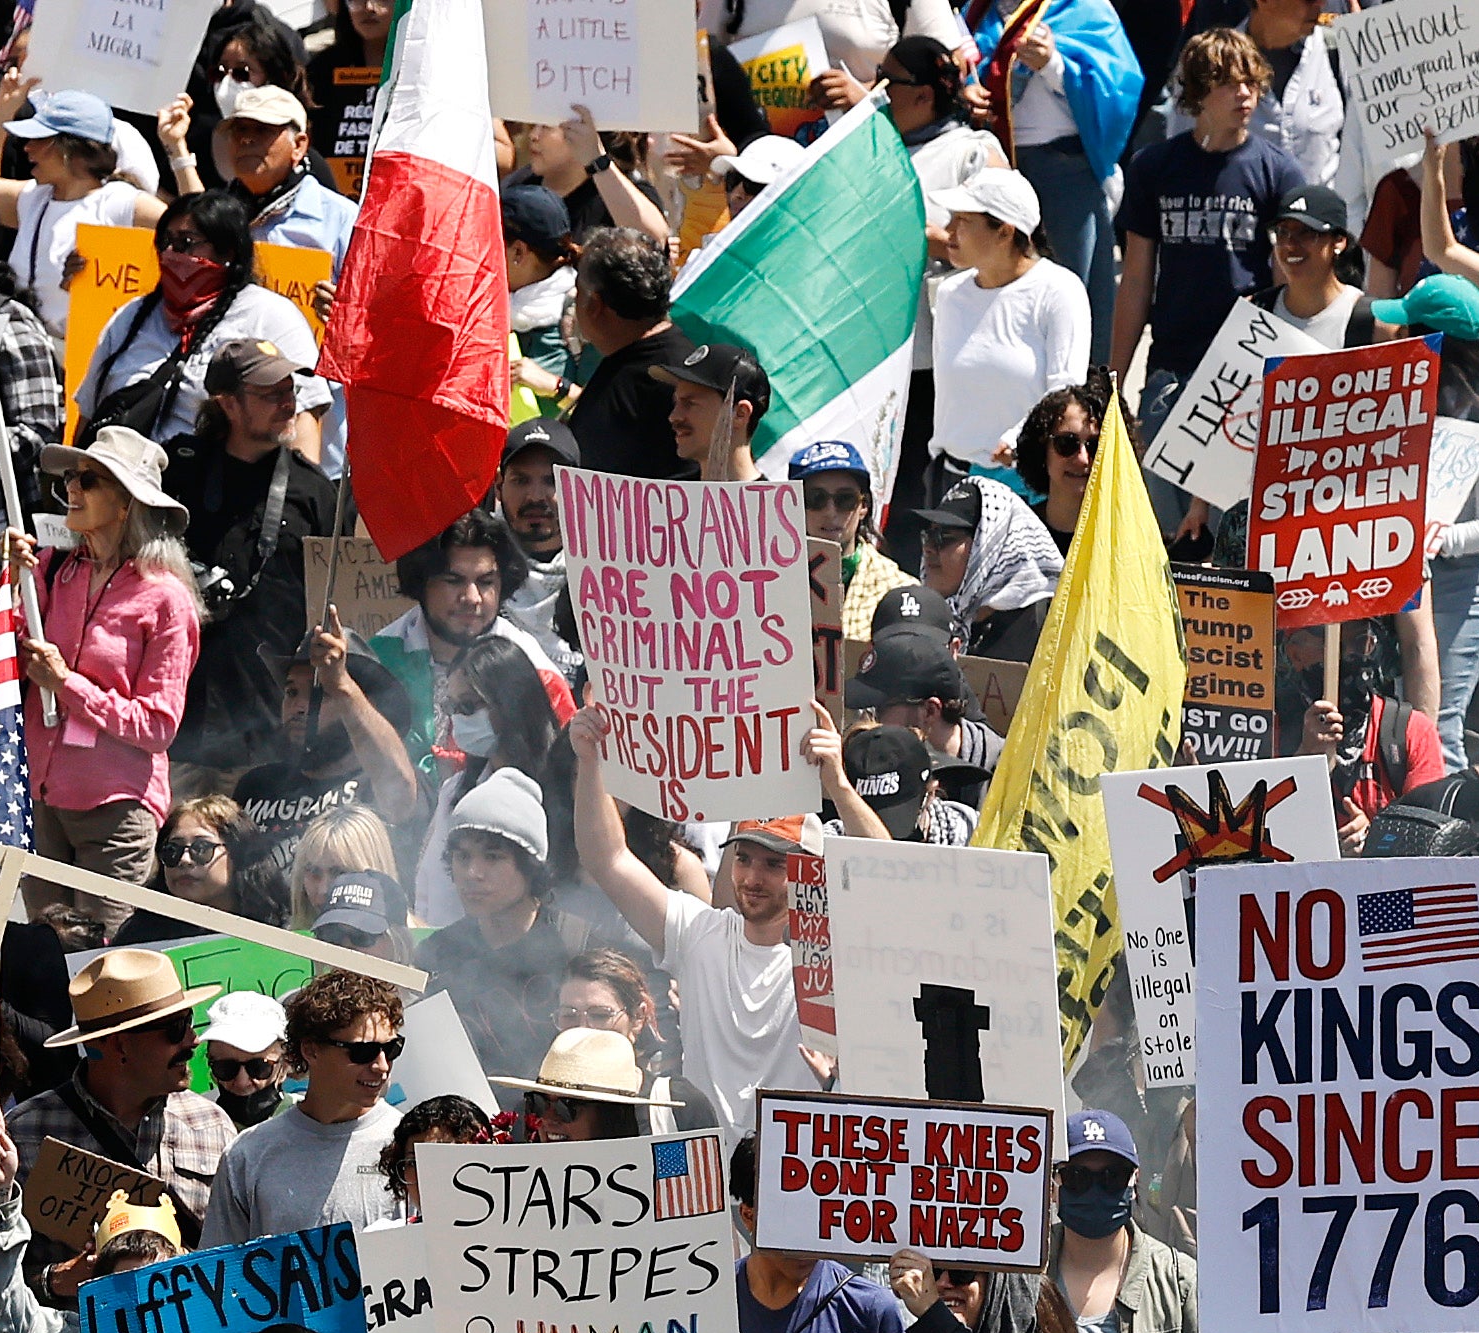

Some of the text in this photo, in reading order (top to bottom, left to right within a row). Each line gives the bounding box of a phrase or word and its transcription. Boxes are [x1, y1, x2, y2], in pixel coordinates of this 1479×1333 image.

[537, 17, 631, 41] A LITTLE
[535, 61, 632, 96] BITCH
[1274, 359, 1430, 406] NO ONE IS
[1269, 392, 1427, 447] ILLEGAL
[561, 467, 801, 569] IMMIGRANTS
[1261, 466, 1420, 520] STOLEN
[1259, 516, 1416, 582] LAND
[579, 569, 779, 620] ARE NOT
[584, 612, 793, 670] CRIMINALS
[602, 676, 759, 712] BUT THE
[601, 707, 801, 781] PRESIDENT
[659, 777, 704, 823] IS.
[1238, 888, 1345, 983] NO
[774, 1110, 1039, 1175] THESE KNEES
[453, 1162, 649, 1231] STARS
[912, 1162, 1009, 1204] BEND
[819, 1198, 1025, 1252] FOR NAZIS
[461, 1241, 721, 1303] STRIPES
